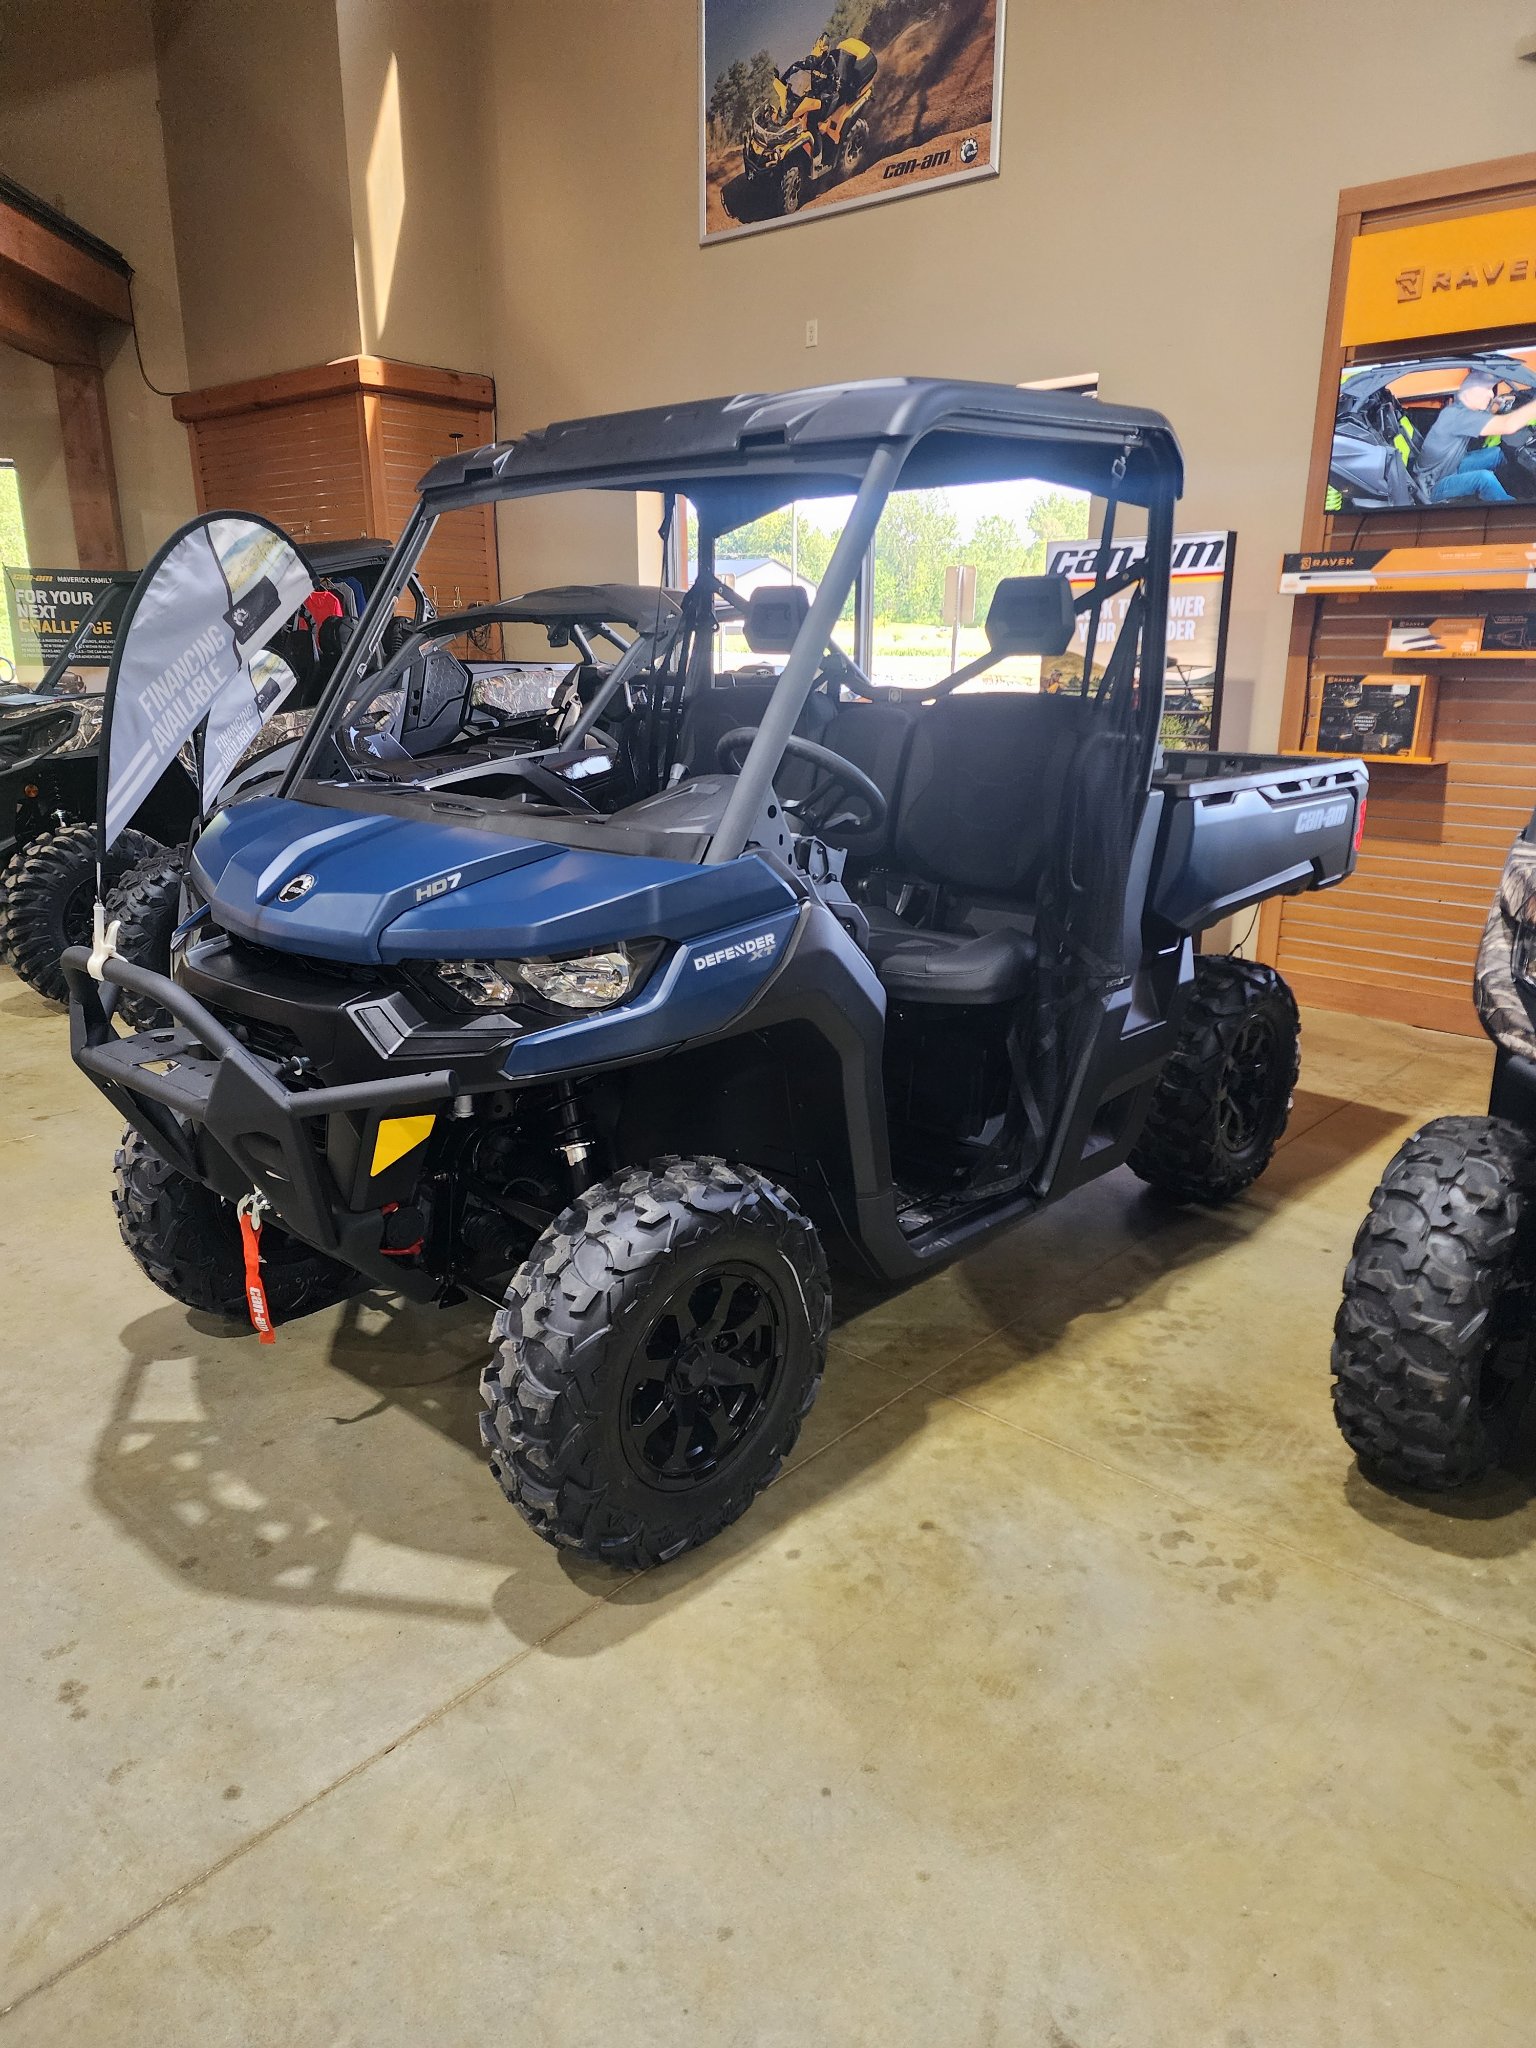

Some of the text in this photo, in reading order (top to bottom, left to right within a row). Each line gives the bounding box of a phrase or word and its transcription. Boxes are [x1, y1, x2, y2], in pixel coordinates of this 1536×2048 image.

[883, 149, 951, 179] can-am
[1432, 257, 1536, 293] RAVE
[1047, 540, 1224, 576] can-m
[1311, 558, 1356, 567] RAVEK
[13, 574, 53, 582] can-am
[15, 589, 94, 605] FOR YOUR
[16, 605, 57, 619] NEXT
[17, 619, 113, 635] CHALLEGE
[1079, 622, 1116, 642] YUR
[138, 624, 226, 722] FINANCING
[151, 657, 228, 756] AVAILABLE
[214, 703, 254, 753] FINANCING
[221, 720, 257, 771] AVAILABLE
[1293, 803, 1348, 835] can-am
[415, 872, 462, 902] HD7
[693, 932, 776, 971] DEFENDER
[748, 944, 776, 963] XT
